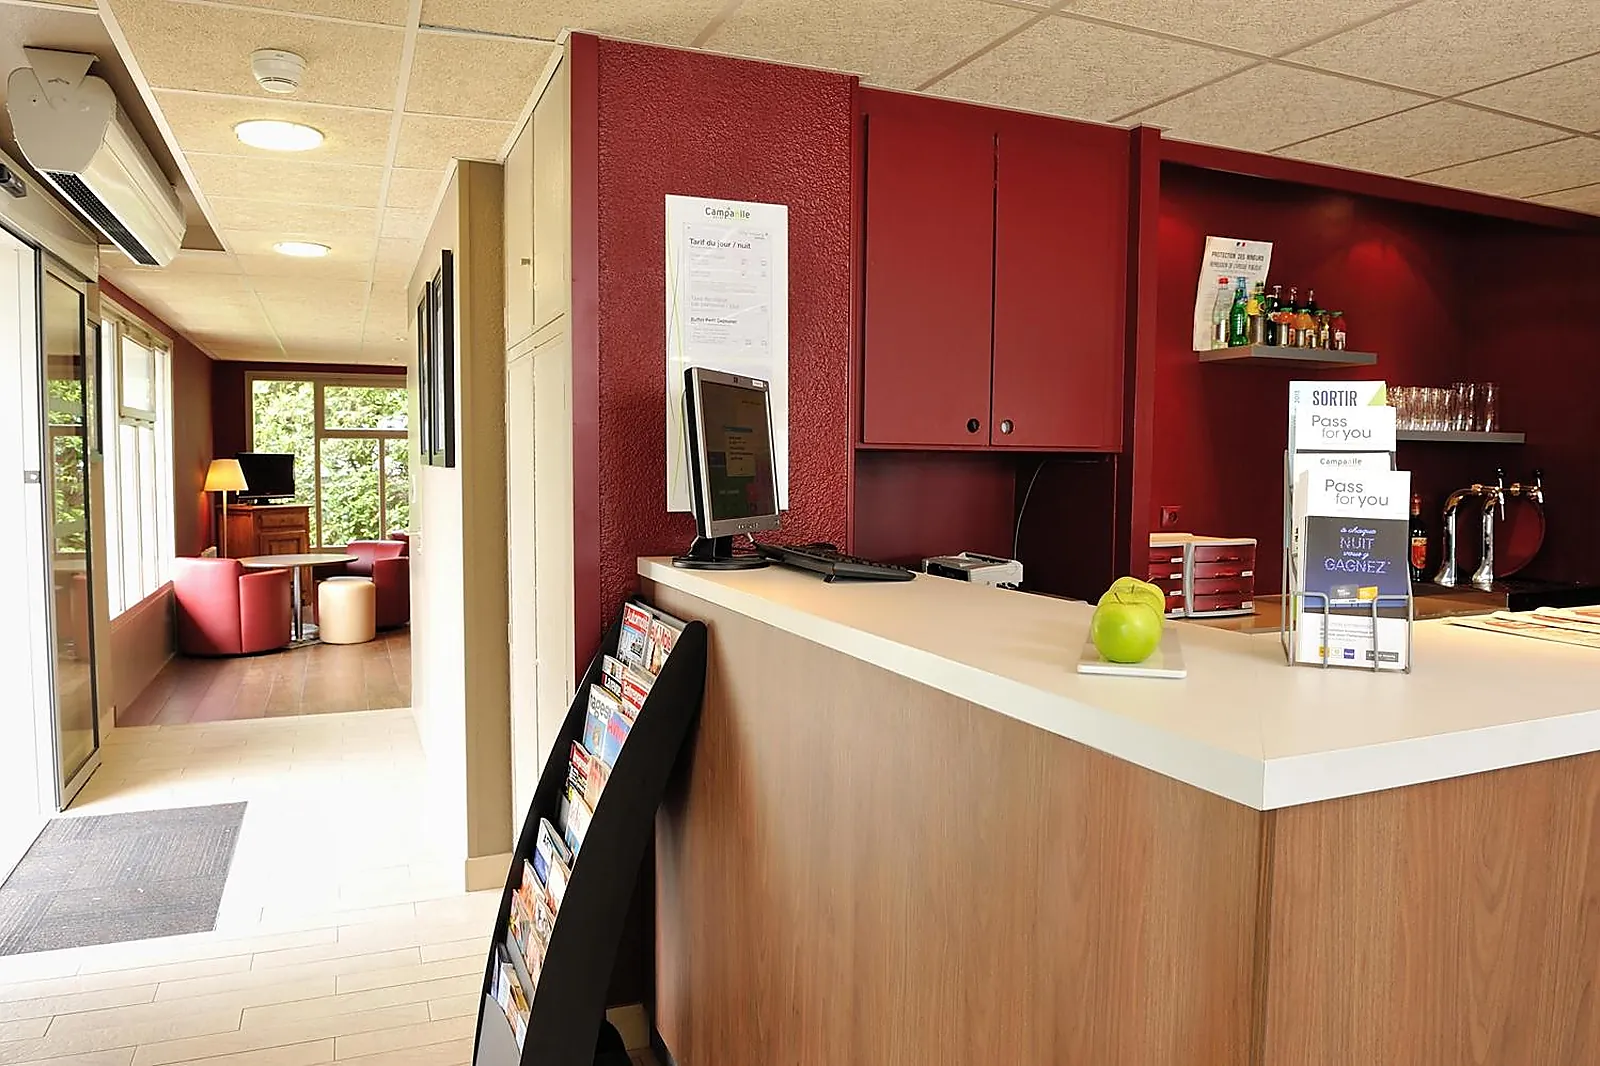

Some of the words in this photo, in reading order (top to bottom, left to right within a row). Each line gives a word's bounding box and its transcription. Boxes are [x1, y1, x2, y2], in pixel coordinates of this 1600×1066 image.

[689, 238, 705, 246] Tarif
[717, 240, 730, 248] jour
[737, 241, 751, 249] nuit
[1212, 251, 1236, 259] PROTECTION
[1312, 390, 1358, 407] SORTIR
[1312, 415, 1347, 428] Pass
[1322, 427, 1339, 439] for
[1342, 429, 1371, 441] you
[1325, 479, 1363, 493] Pass
[1336, 493, 1355, 505] for
[1358, 496, 1389, 508] you
[1340, 537, 1375, 550] NUIT
